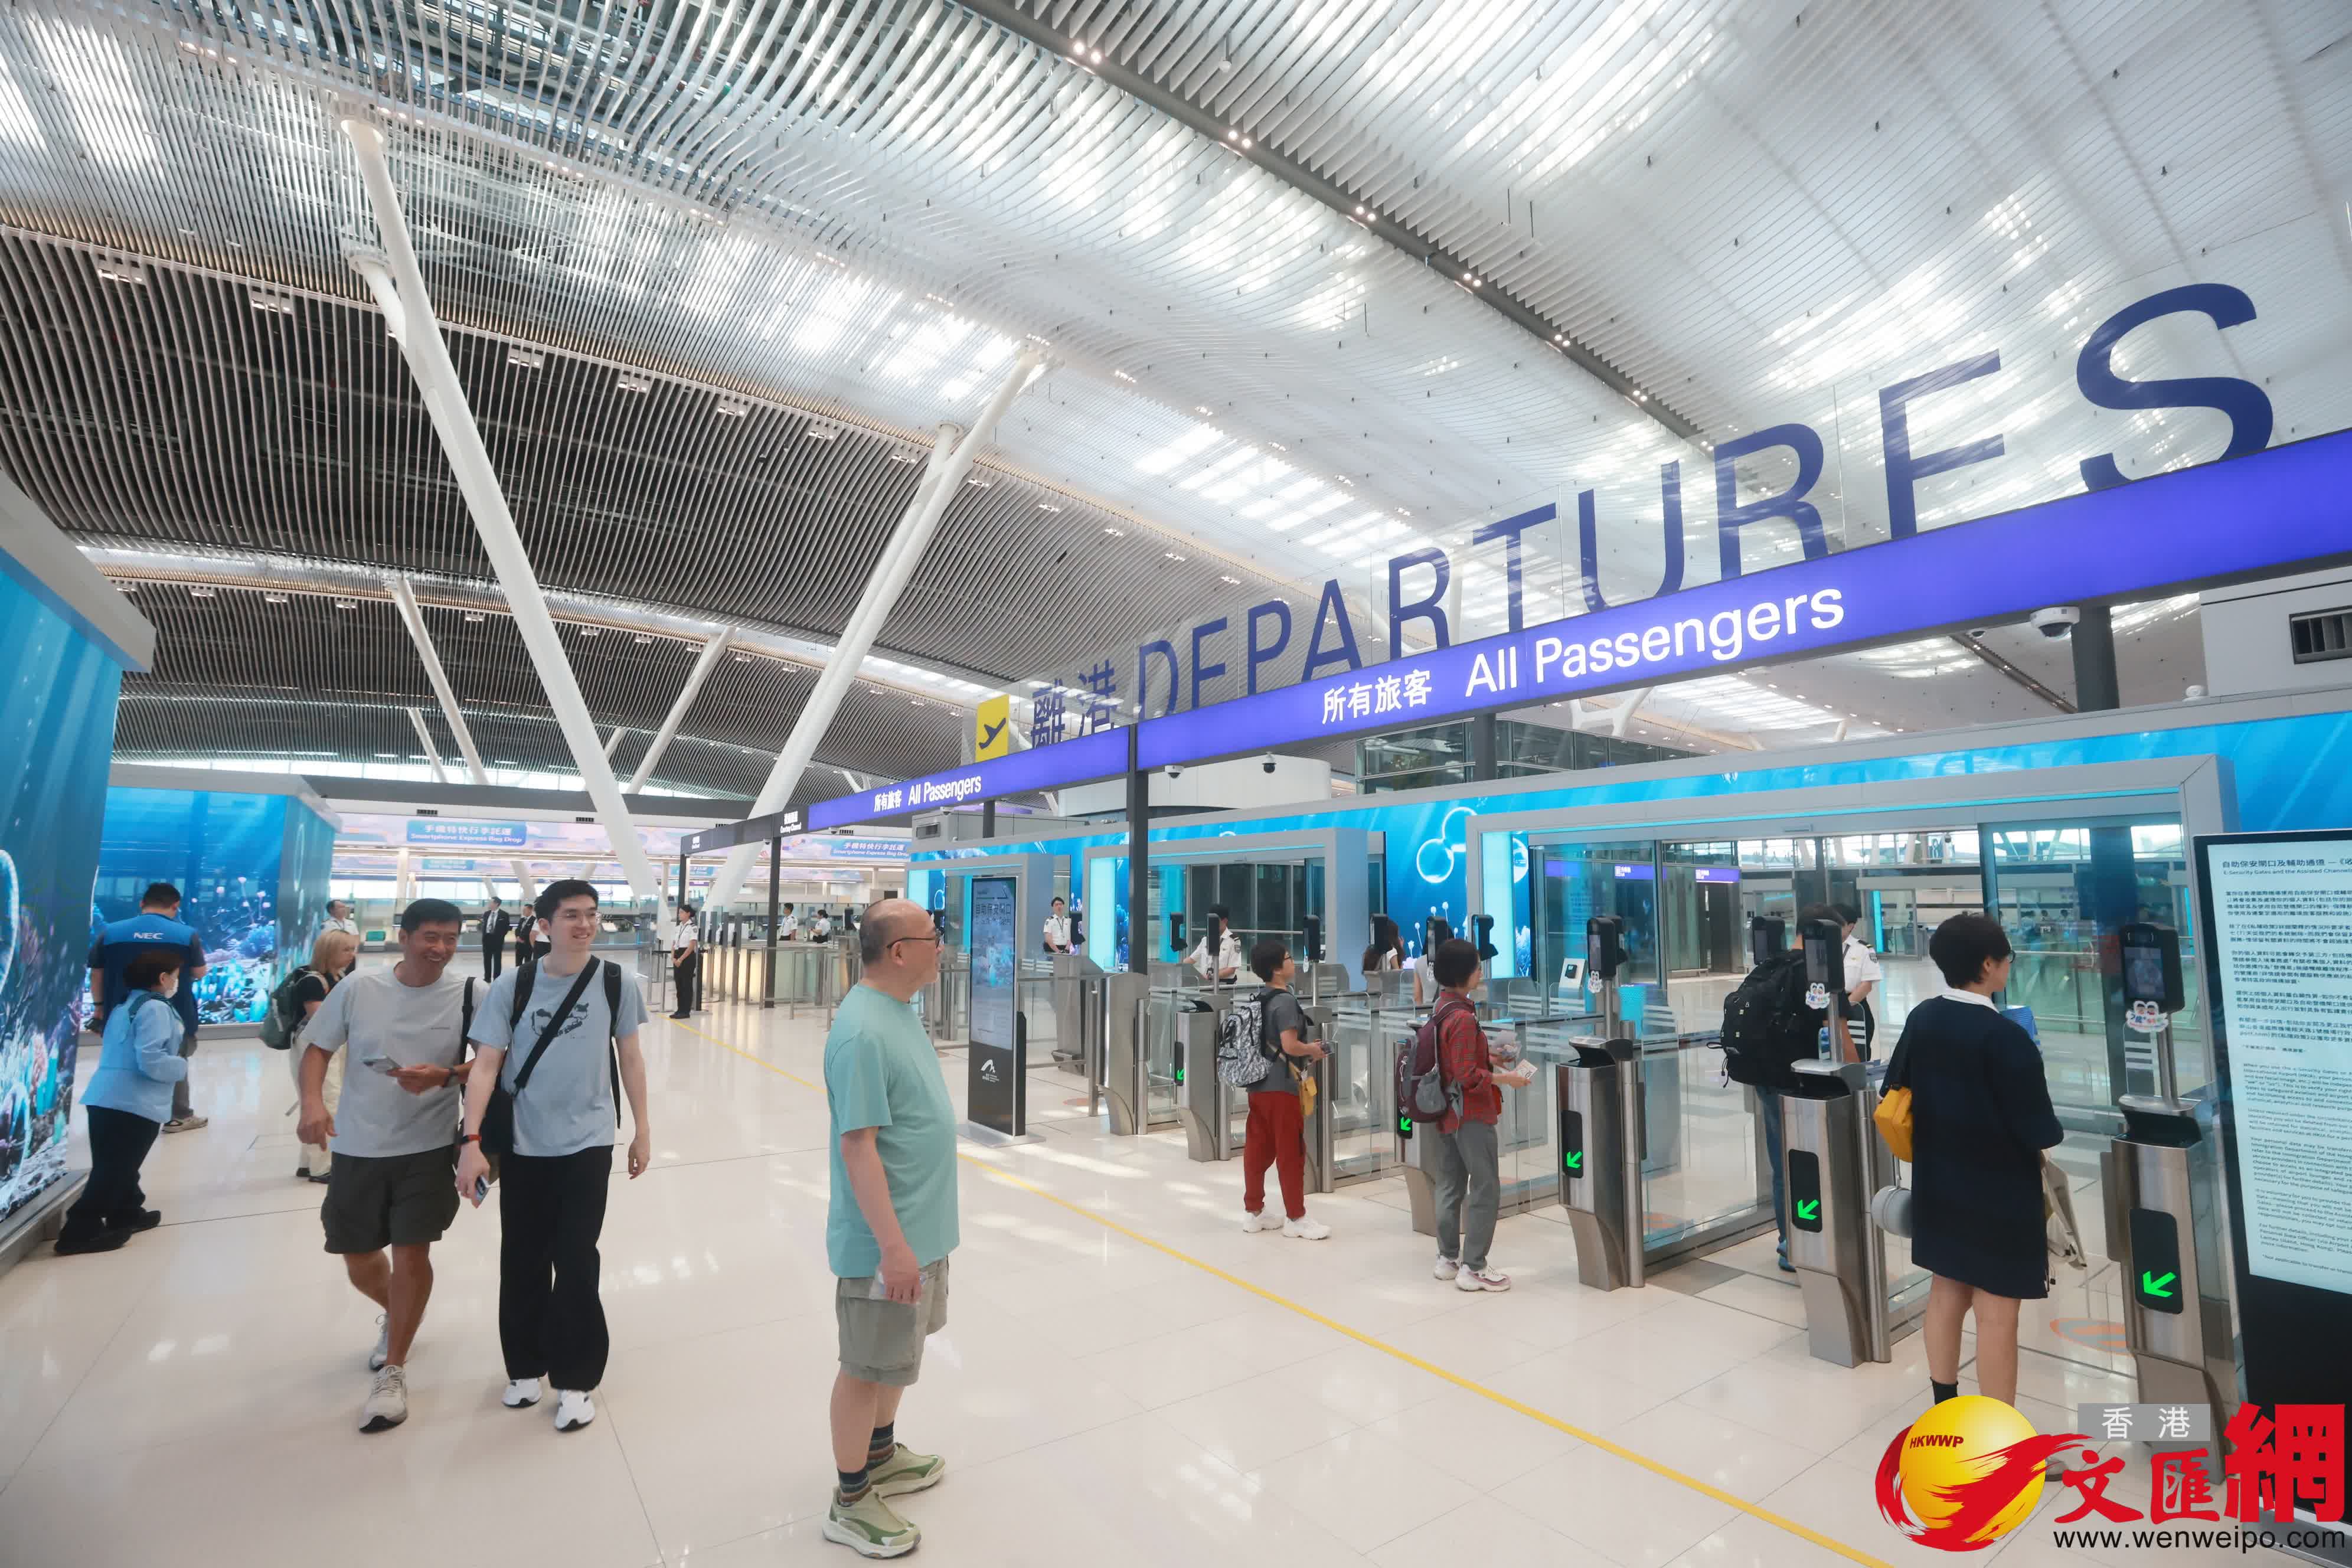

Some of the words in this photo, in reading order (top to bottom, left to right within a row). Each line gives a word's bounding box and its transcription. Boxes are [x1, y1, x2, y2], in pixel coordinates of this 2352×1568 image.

[1322, 669, 1433, 725] 所有旅客
[1465, 645, 1518, 697] All
[1536, 587, 1845, 684] Passengers
[1031, 659, 1116, 749] 離港
[874, 789, 901, 812] 所有旅客
[908, 783, 921, 805] All
[923, 775, 981, 801] Passengers
